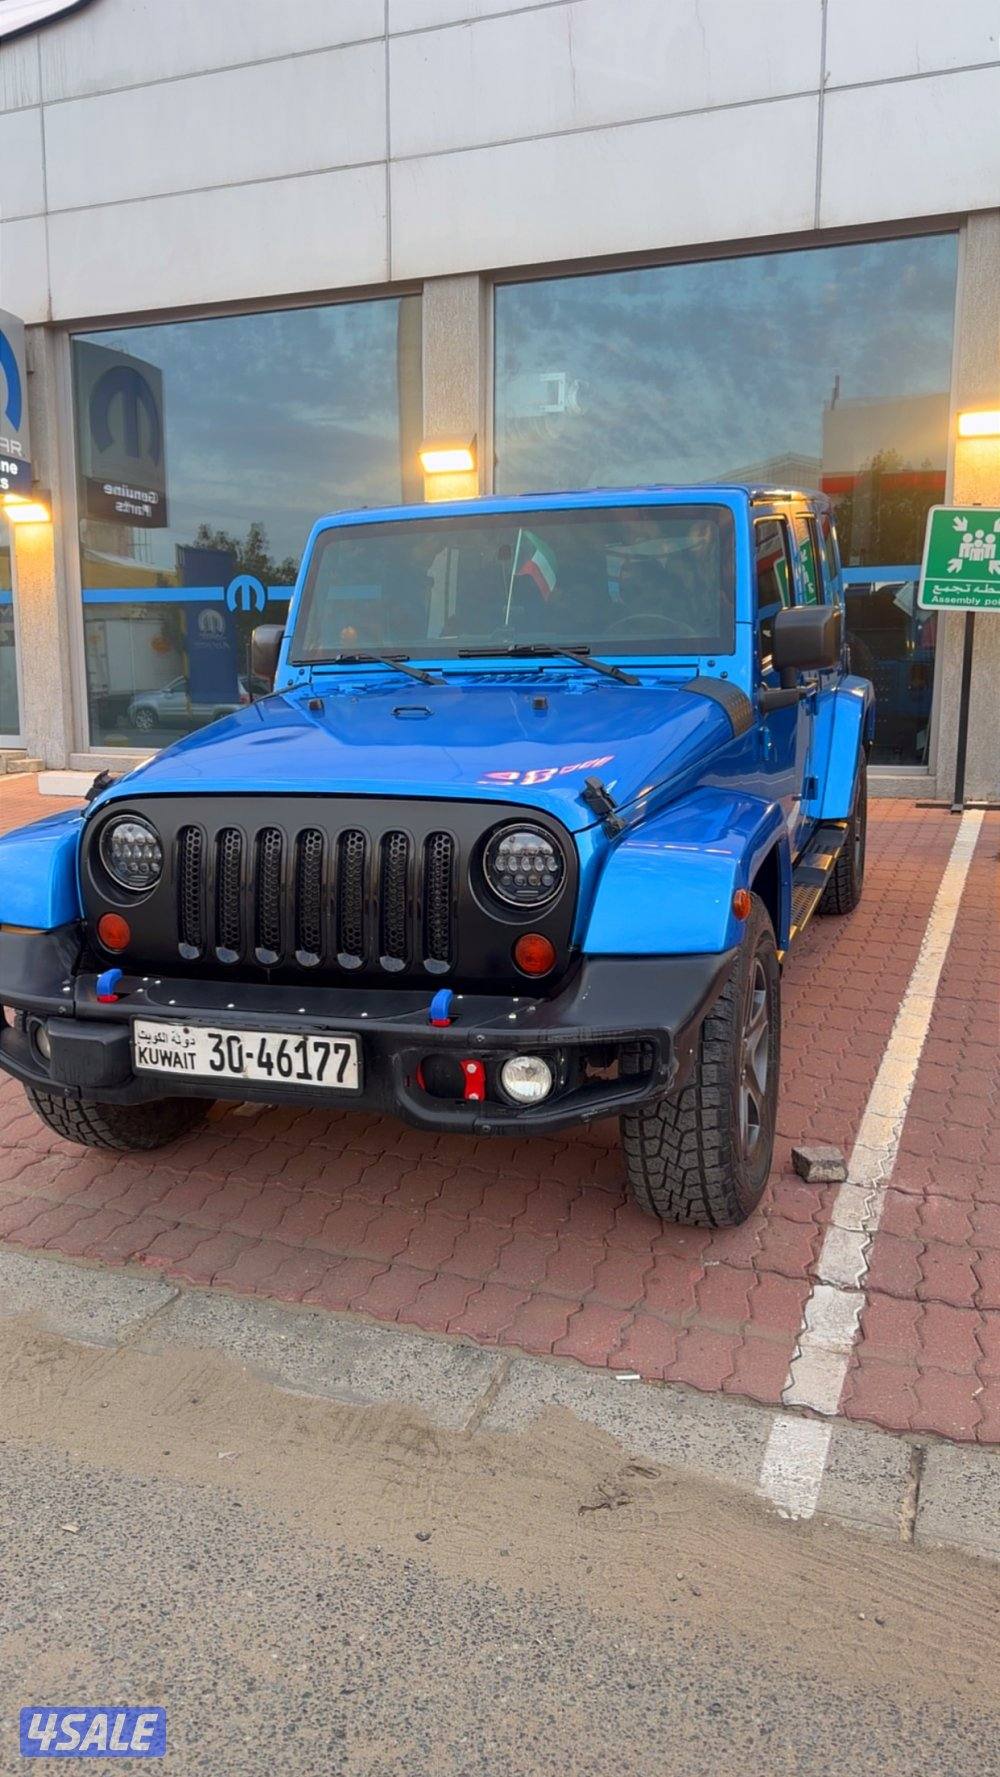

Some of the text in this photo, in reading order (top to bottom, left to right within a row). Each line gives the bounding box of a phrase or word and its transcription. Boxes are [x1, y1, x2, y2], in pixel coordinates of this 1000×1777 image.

[931, 596, 981, 606] Assembly
[138, 1030, 196, 1048] دولة الكويت
[138, 1046, 196, 1070] KUWAIT
[207, 1032, 352, 1083] 30-46177
